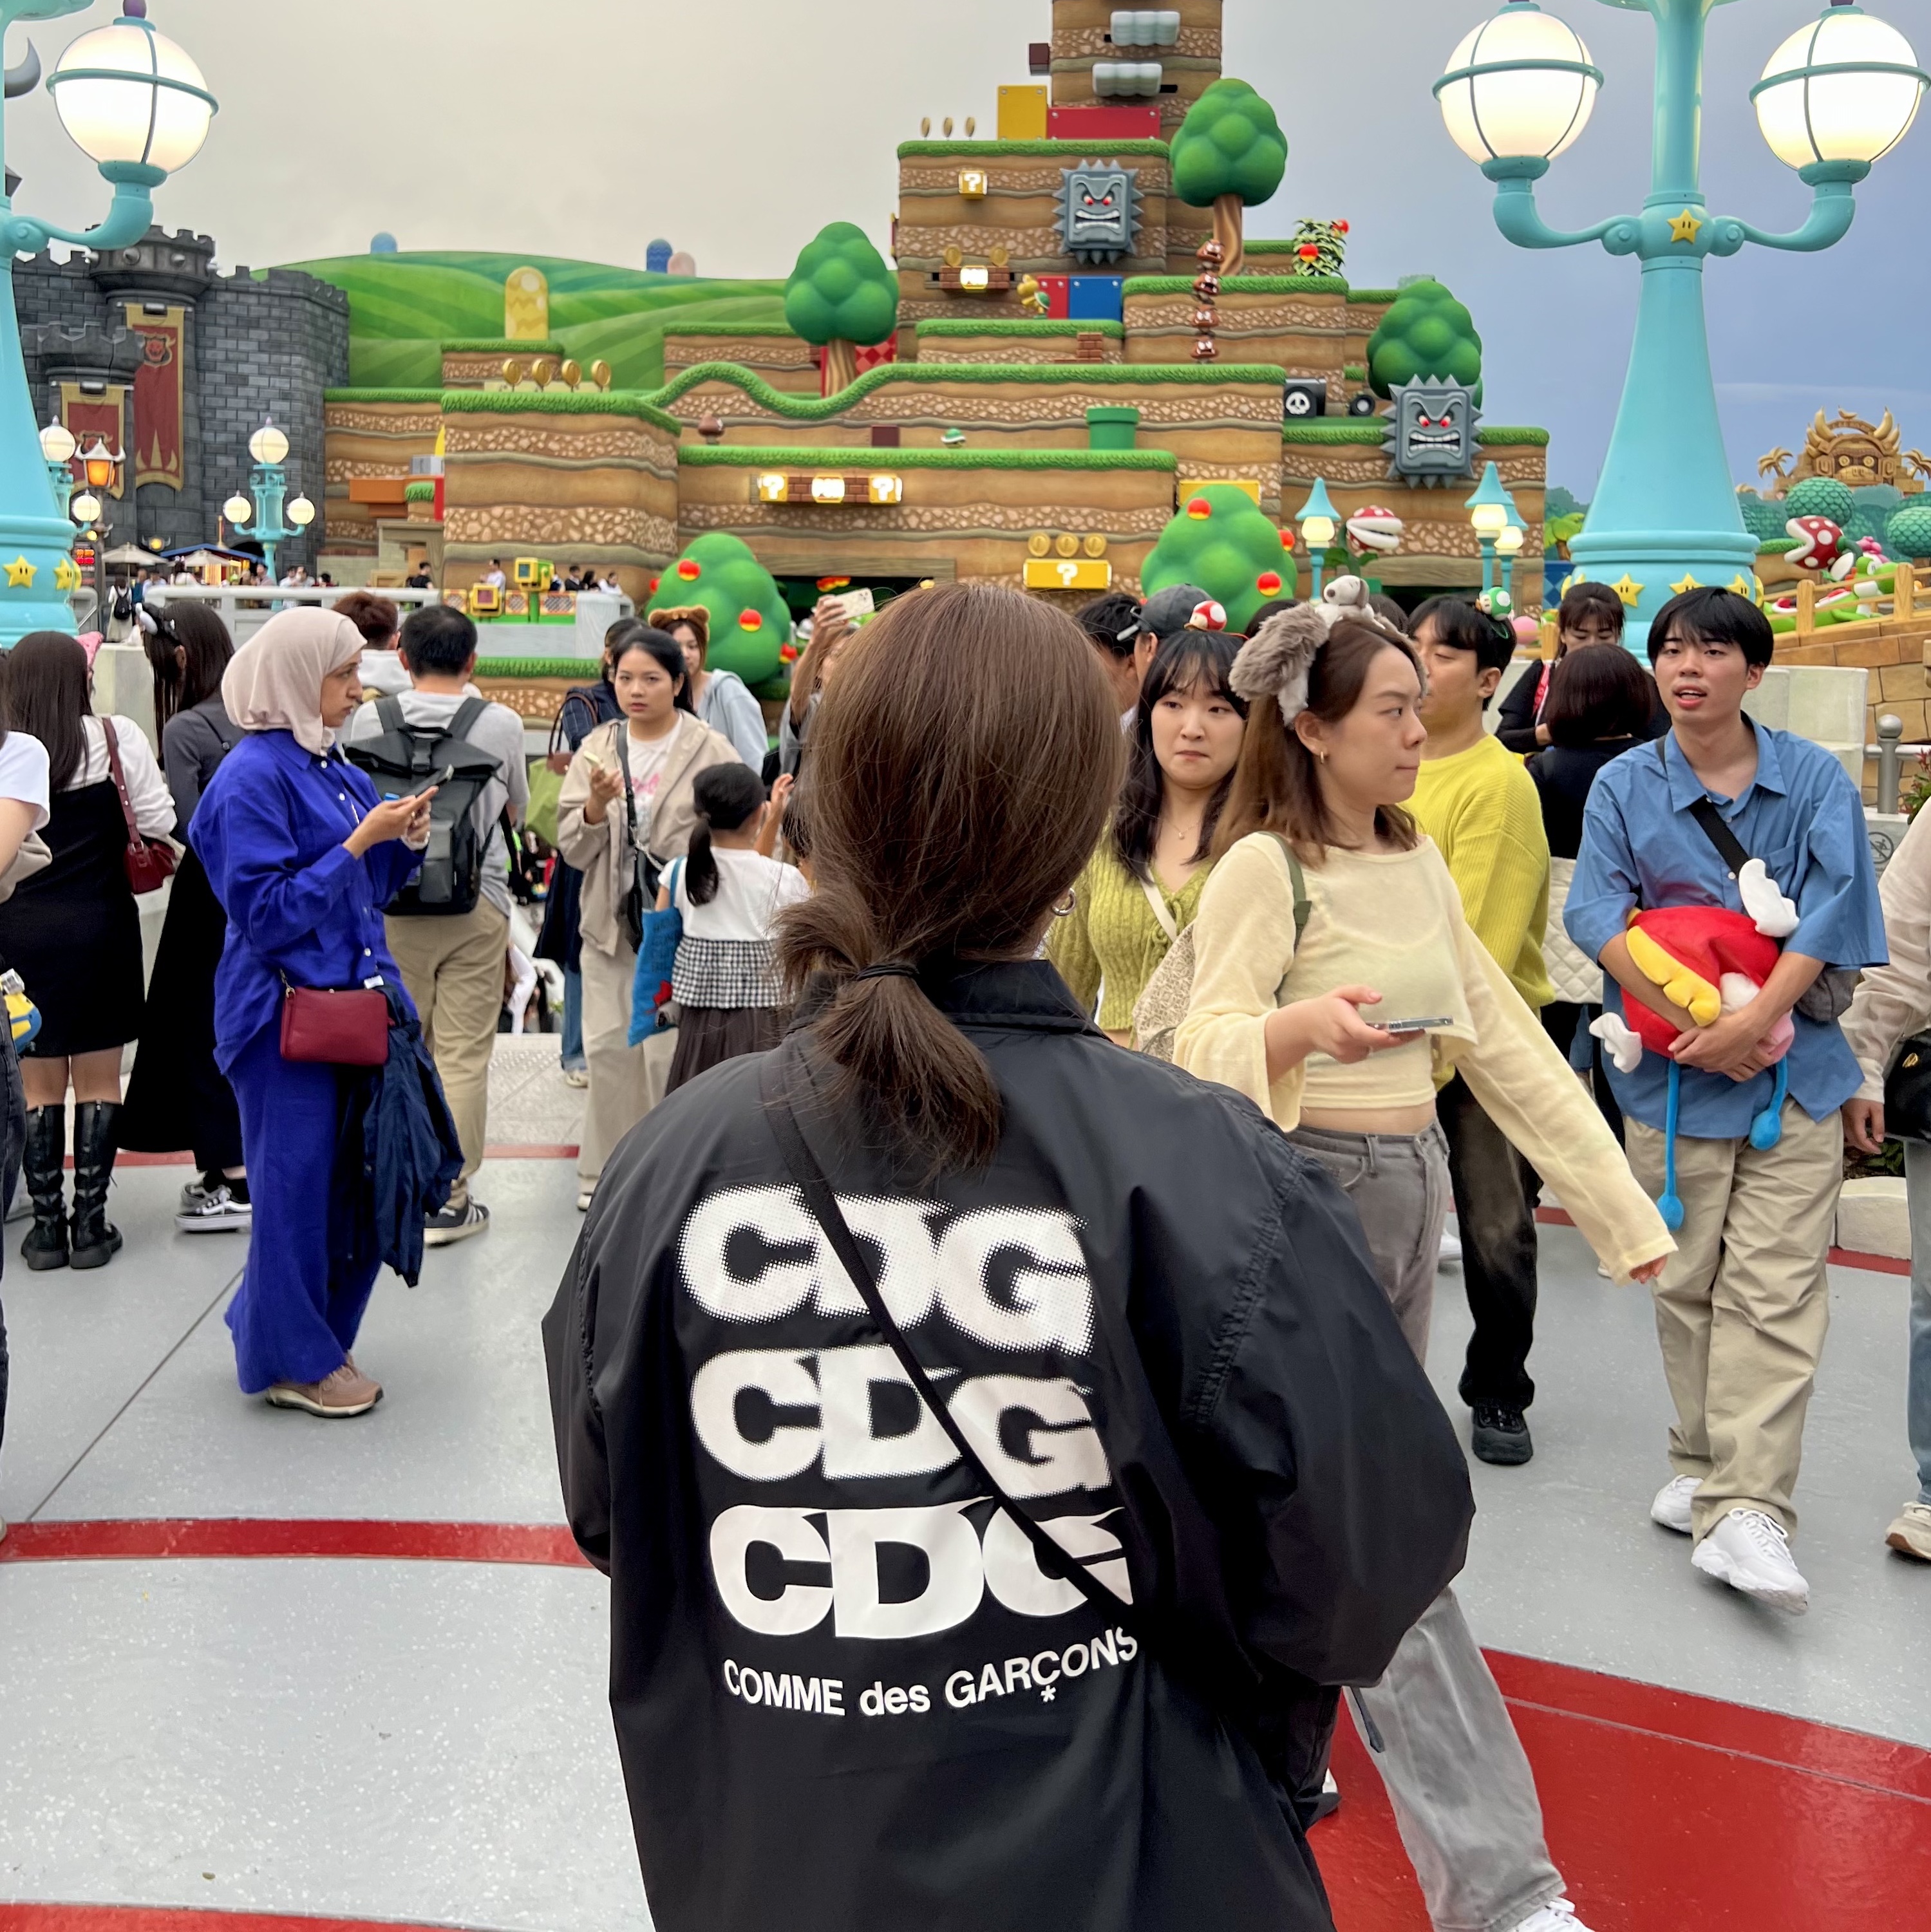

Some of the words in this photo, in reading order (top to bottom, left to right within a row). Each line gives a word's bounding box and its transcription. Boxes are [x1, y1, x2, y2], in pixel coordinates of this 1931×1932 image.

[677, 1183, 1095, 1356] CDG
[690, 1343, 1112, 1500] CDG
[724, 1658, 845, 1716] COMME
[859, 1681, 931, 1717] des
